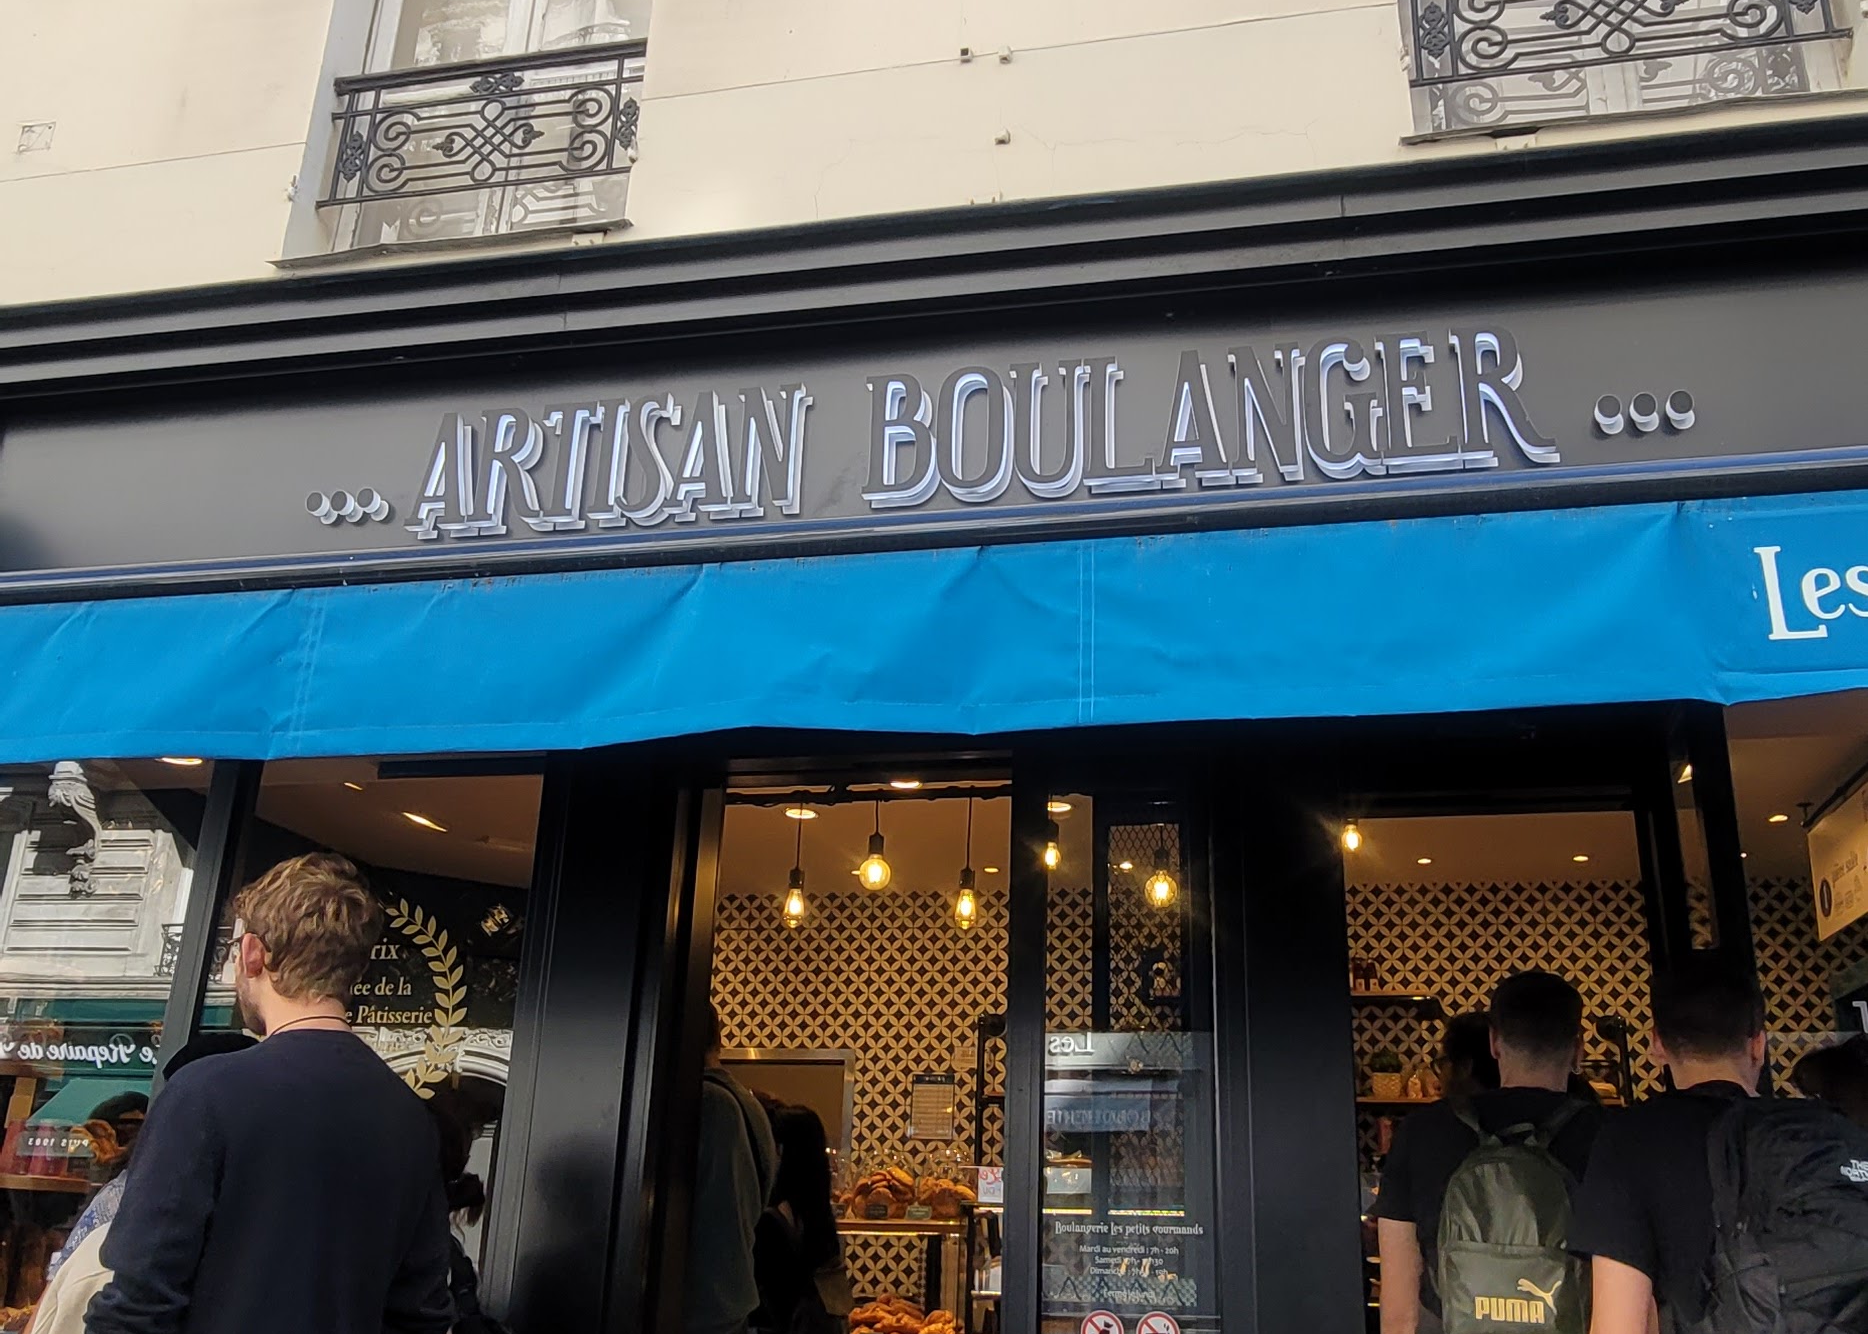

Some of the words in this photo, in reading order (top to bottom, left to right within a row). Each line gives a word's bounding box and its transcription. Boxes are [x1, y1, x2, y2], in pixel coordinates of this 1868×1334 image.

[403, 381, 813, 540] ARTISAN
[860, 325, 1562, 510] BOULANGER
[1753, 545, 1868, 640] Les
[369, 937, 401, 961] rix
[374, 976, 395, 996] de
[397, 975, 412, 996] la
[356, 1005, 433, 1024] Pâtisserie
[1055, 1221, 1108, 1235] Boulangerie
[1125, 1222, 1150, 1237] petits
[1152, 1223, 1204, 1236] gourmands
[1079, 1244, 1101, 1253] Mardi
[1112, 1245, 1145, 1254] vendredi
[1474, 1296, 1545, 1324] PUMA
